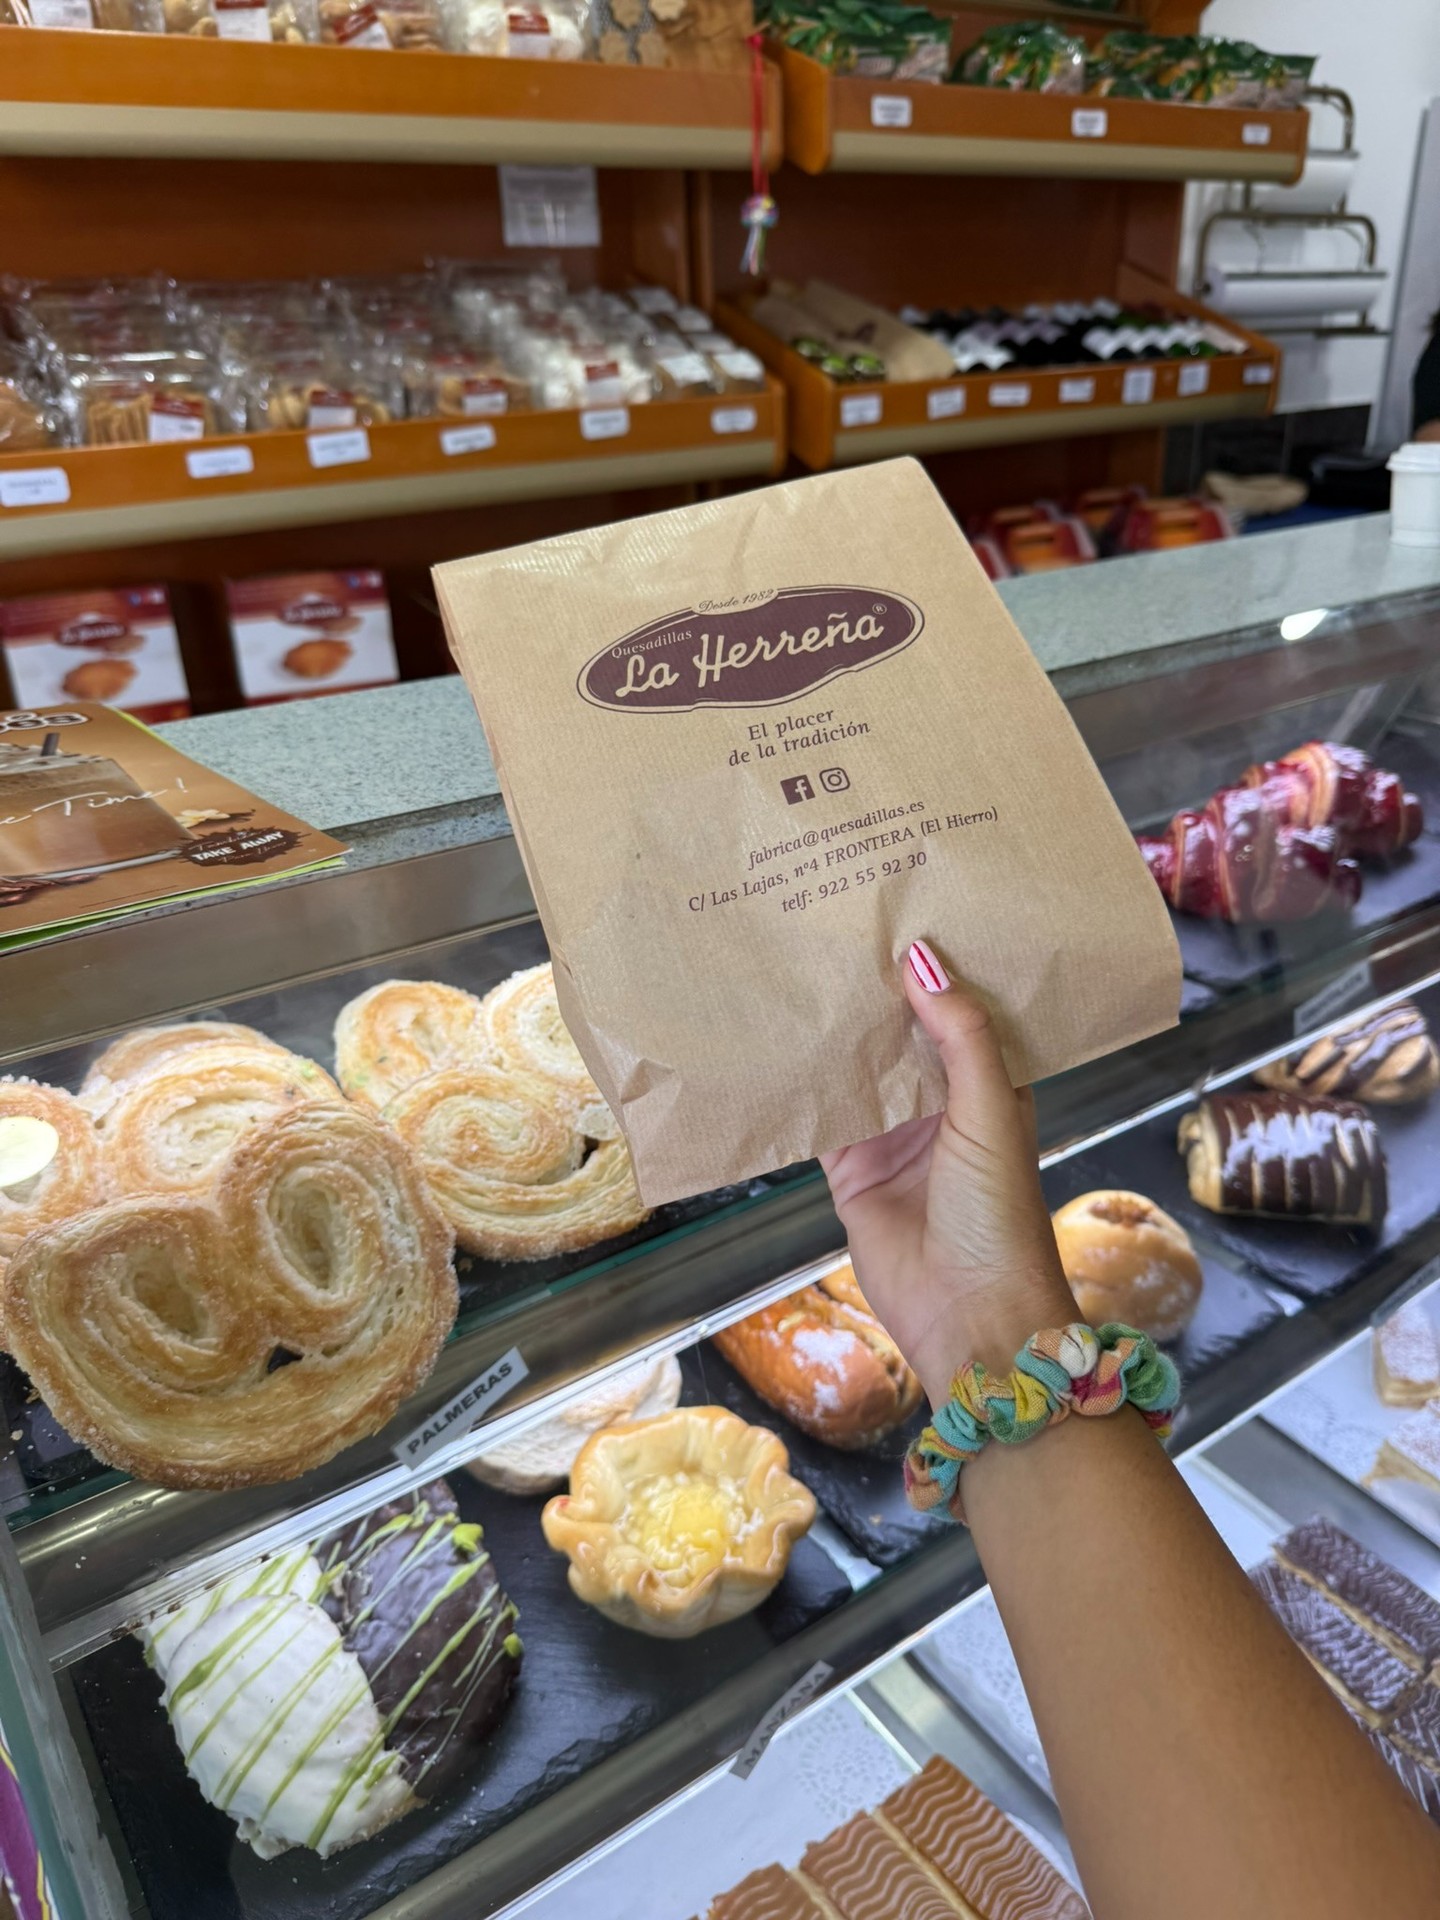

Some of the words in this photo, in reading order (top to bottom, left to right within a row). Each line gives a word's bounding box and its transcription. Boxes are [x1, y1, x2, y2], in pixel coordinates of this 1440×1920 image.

[699, 597, 739, 613] Desde
[743, 588, 774, 604] 1982
[611, 630, 692, 659] Quesadillas
[615, 654, 680, 698] La
[692, 612, 885, 688] Herreña
[728, 749, 751, 767] de
[756, 743, 777, 759] la
[783, 721, 871, 753] tradición
[748, 722, 768, 742] El
[775, 709, 834, 739] placer
[191, 846, 236, 861] TAKE
[240, 831, 284, 850] AWAY
[688, 893, 705, 912] C/
[710, 889, 738, 906] Las
[742, 872, 789, 896] Lajas,
[824, 826, 915, 867] FRONTERA
[920, 818, 942, 837] (El
[946, 806, 998, 830] Hierro)
[747, 801, 925, 871] fabrica@quesadillas.es
[782, 889, 813, 913] telf:
[818, 877, 850, 900] 922
[856, 866, 877, 886] 55
[882, 858, 902, 877] 92
[907, 851, 927, 869] 30
[406, 1362, 513, 1455] PALMERAS
